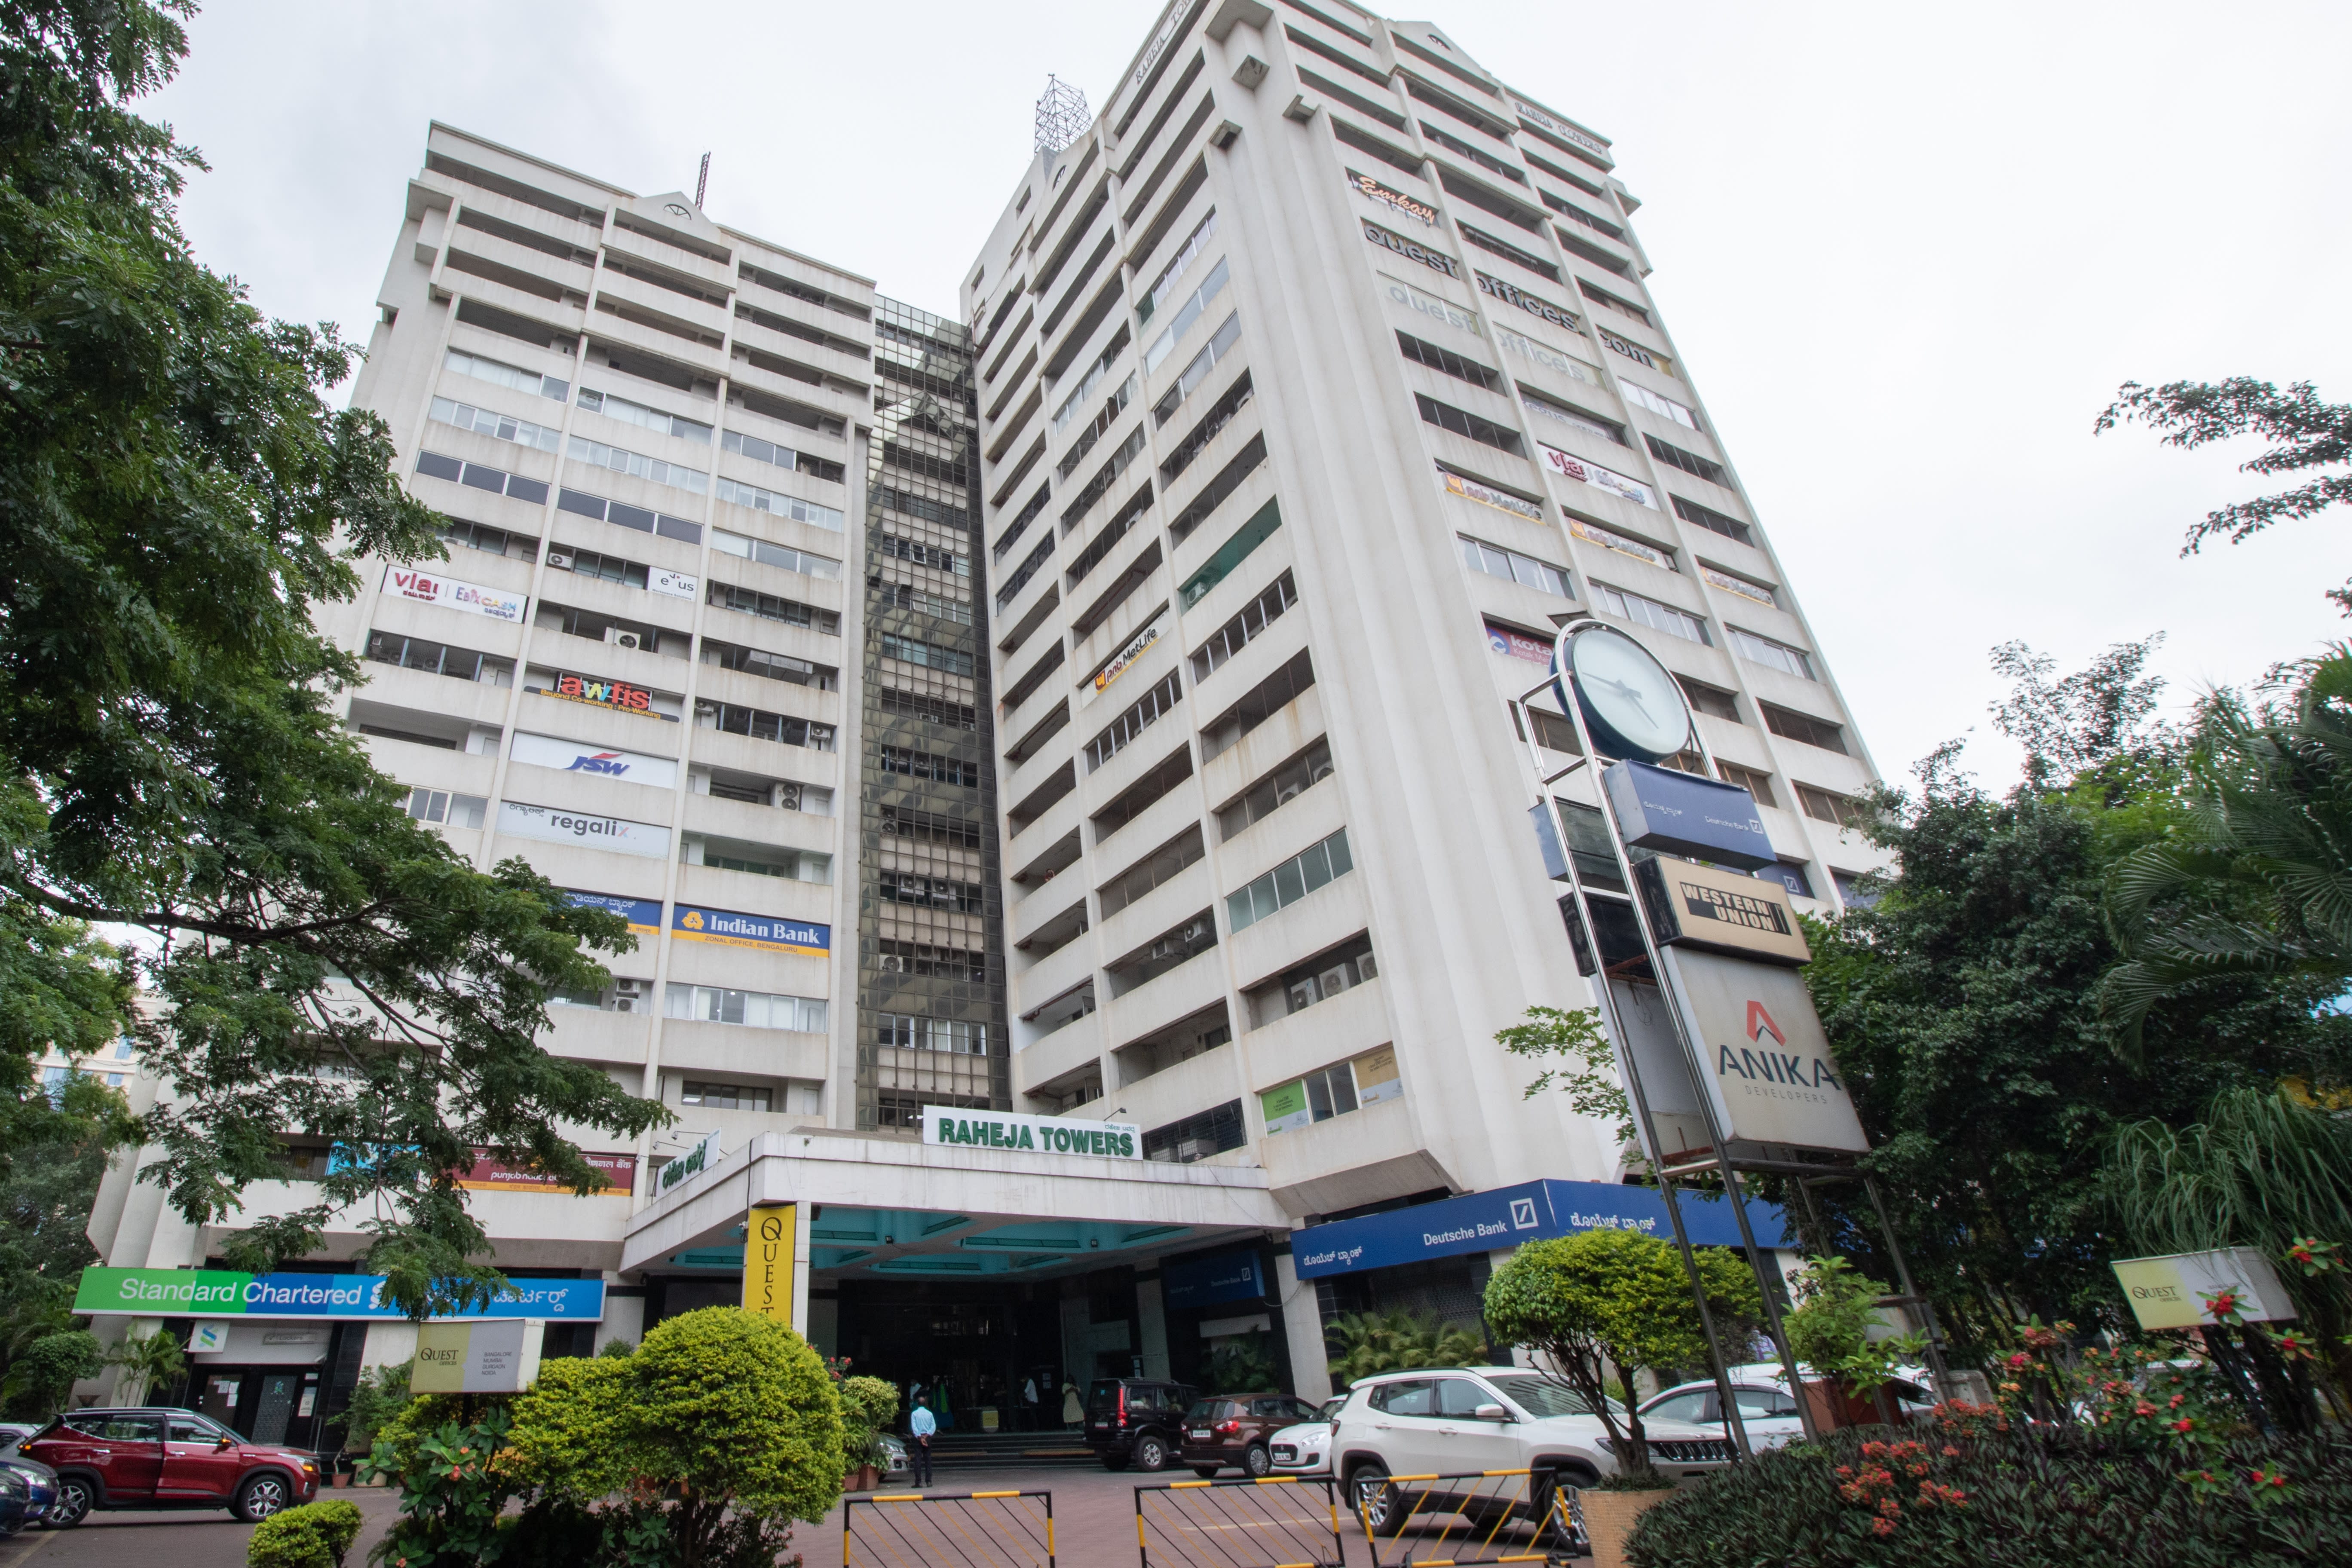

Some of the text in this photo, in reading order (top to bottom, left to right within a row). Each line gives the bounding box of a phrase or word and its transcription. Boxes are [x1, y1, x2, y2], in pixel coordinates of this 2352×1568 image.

[1122, 628, 1157, 665] MetLife
[1510, 634, 1555, 656] kota
[540, 688, 570, 701] Beyond
[571, 695, 613, 710] Co-working
[618, 704, 661, 720] Pro-Working
[561, 676, 649, 710] awfis
[562, 756, 631, 776] JSW
[551, 815, 630, 838] regalix
[1681, 883, 1770, 916] WESTERN
[710, 915, 821, 944] Indian Bank
[1713, 905, 1775, 932] UNION
[705, 935, 727, 943] ZONAL
[757, 943, 798, 952] BENGALURU
[1719, 1044, 1842, 1091] ANIKA
[1745, 1085, 1827, 1104] DEVELOPERS
[939, 1118, 1134, 1156] RAHEJA TOWERS
[491, 1171, 521, 1181] punjab
[1423, 1220, 1508, 1246] Deutsche Bank
[119, 1278, 362, 1305] Standard Chartered
